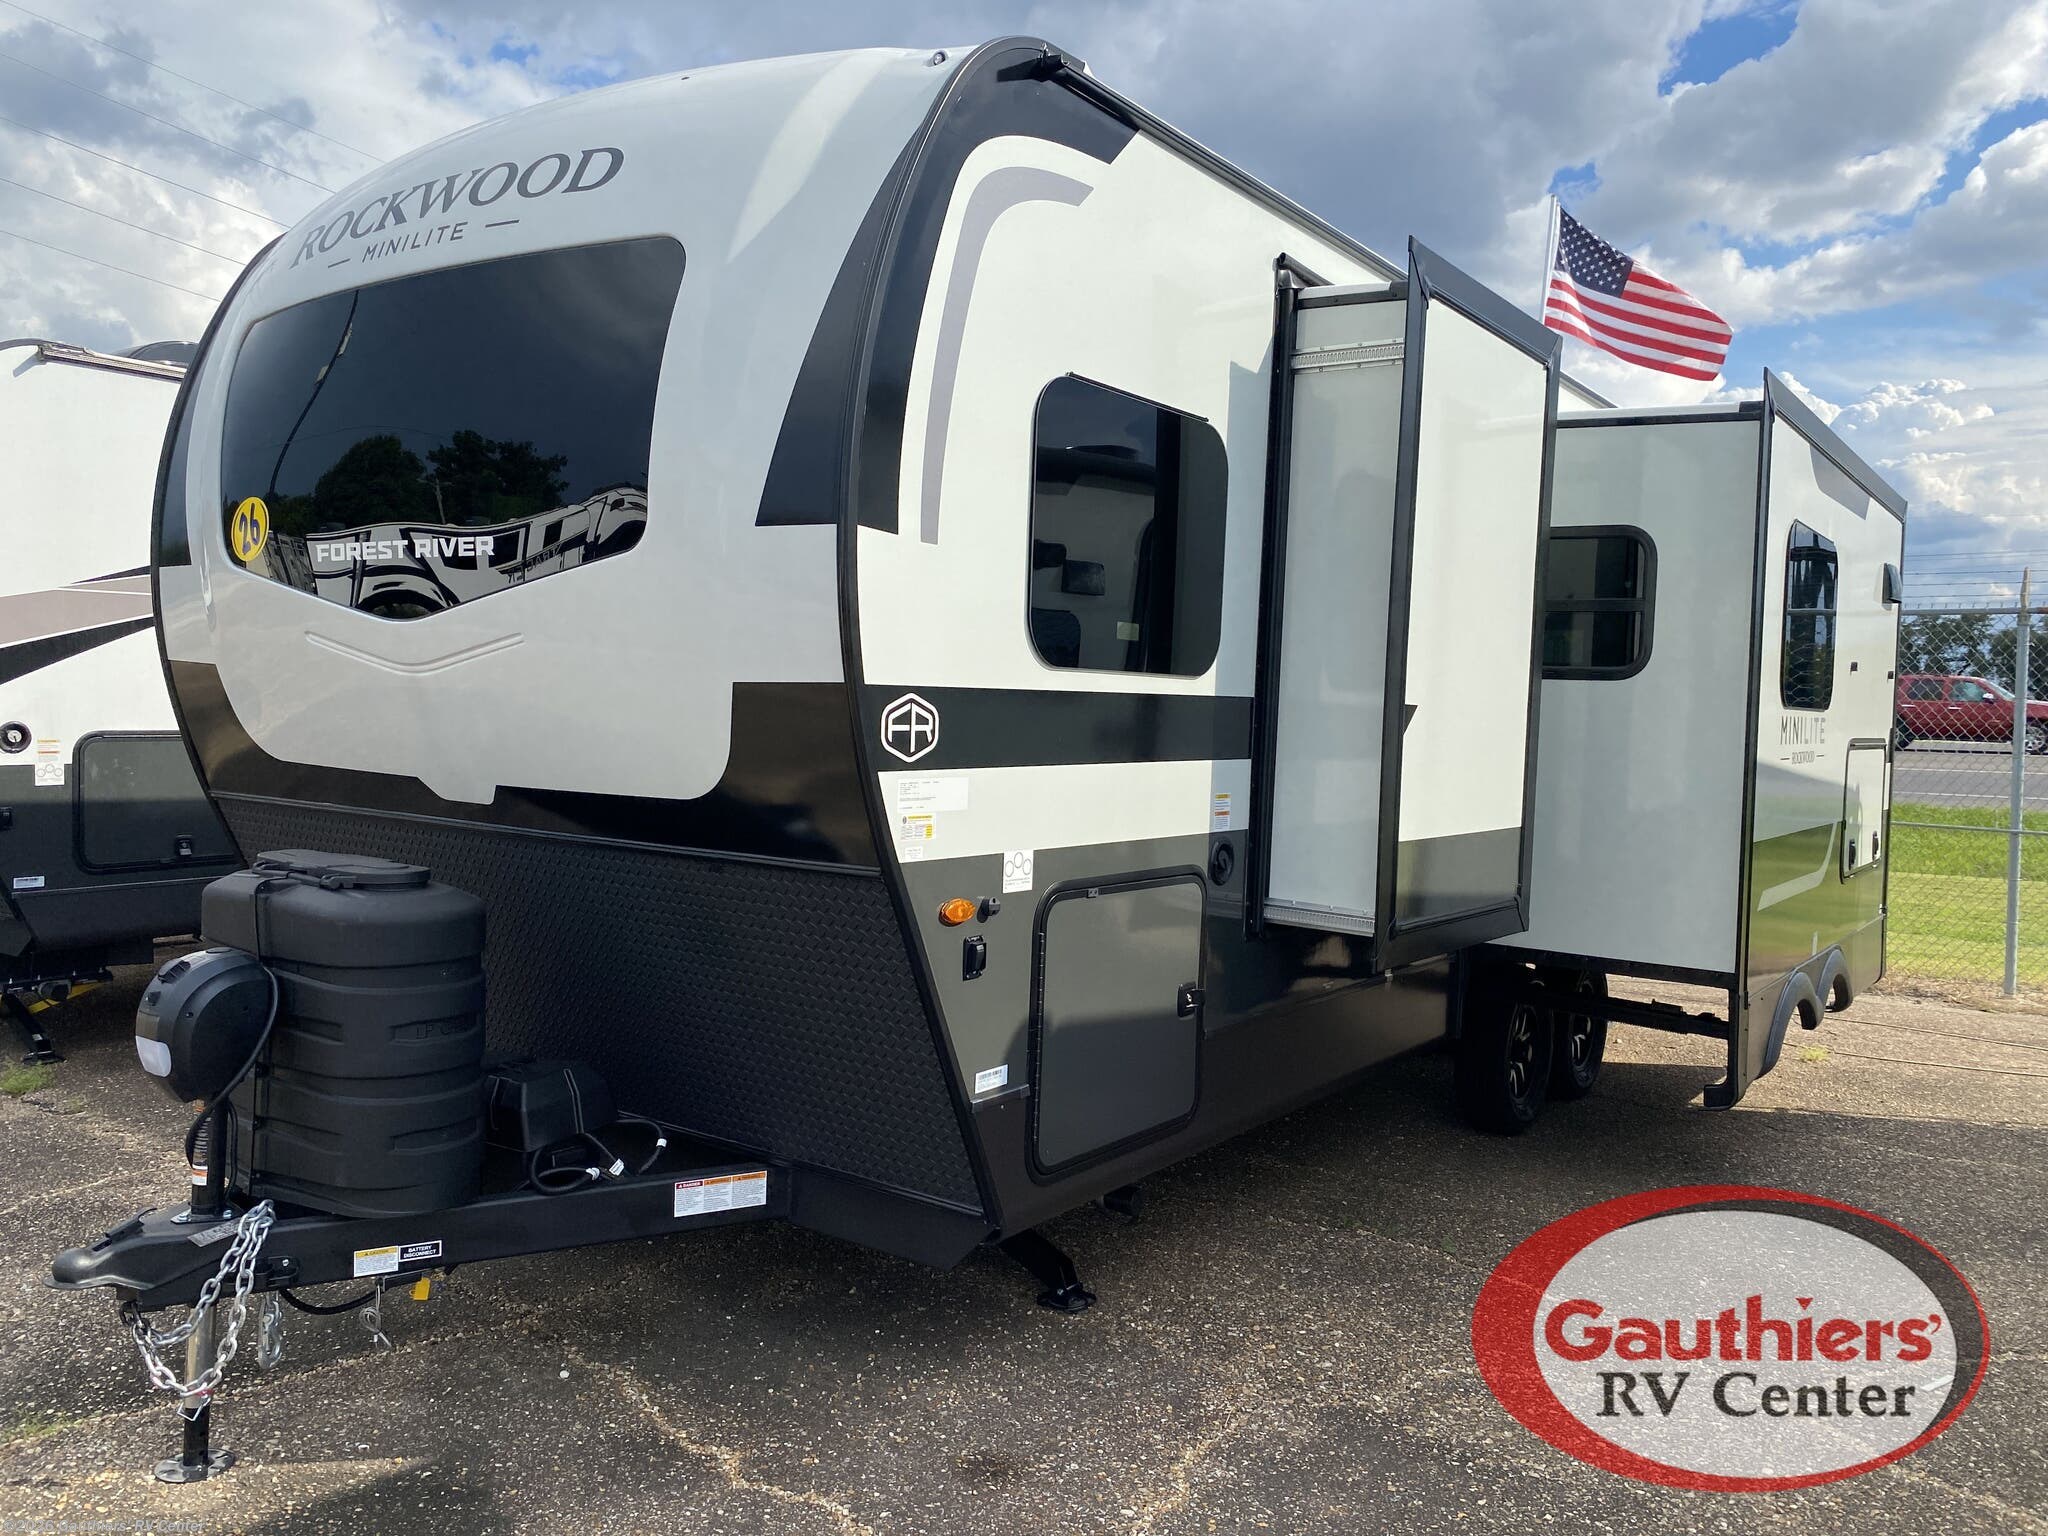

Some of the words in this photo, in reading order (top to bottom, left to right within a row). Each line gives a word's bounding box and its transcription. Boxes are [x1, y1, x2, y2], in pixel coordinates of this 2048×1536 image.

[288, 146, 625, 270] ROCKWOOD
[361, 221, 469, 264] MINILITE
[238, 502, 261, 556] 26
[315, 539, 409, 563] FOREST
[414, 535, 496, 559] RIVER
[1780, 715, 1826, 745] MINILITE
[403, 1249, 437, 1259] DISCONNECT
[408, 1244, 432, 1253] BATTERY
